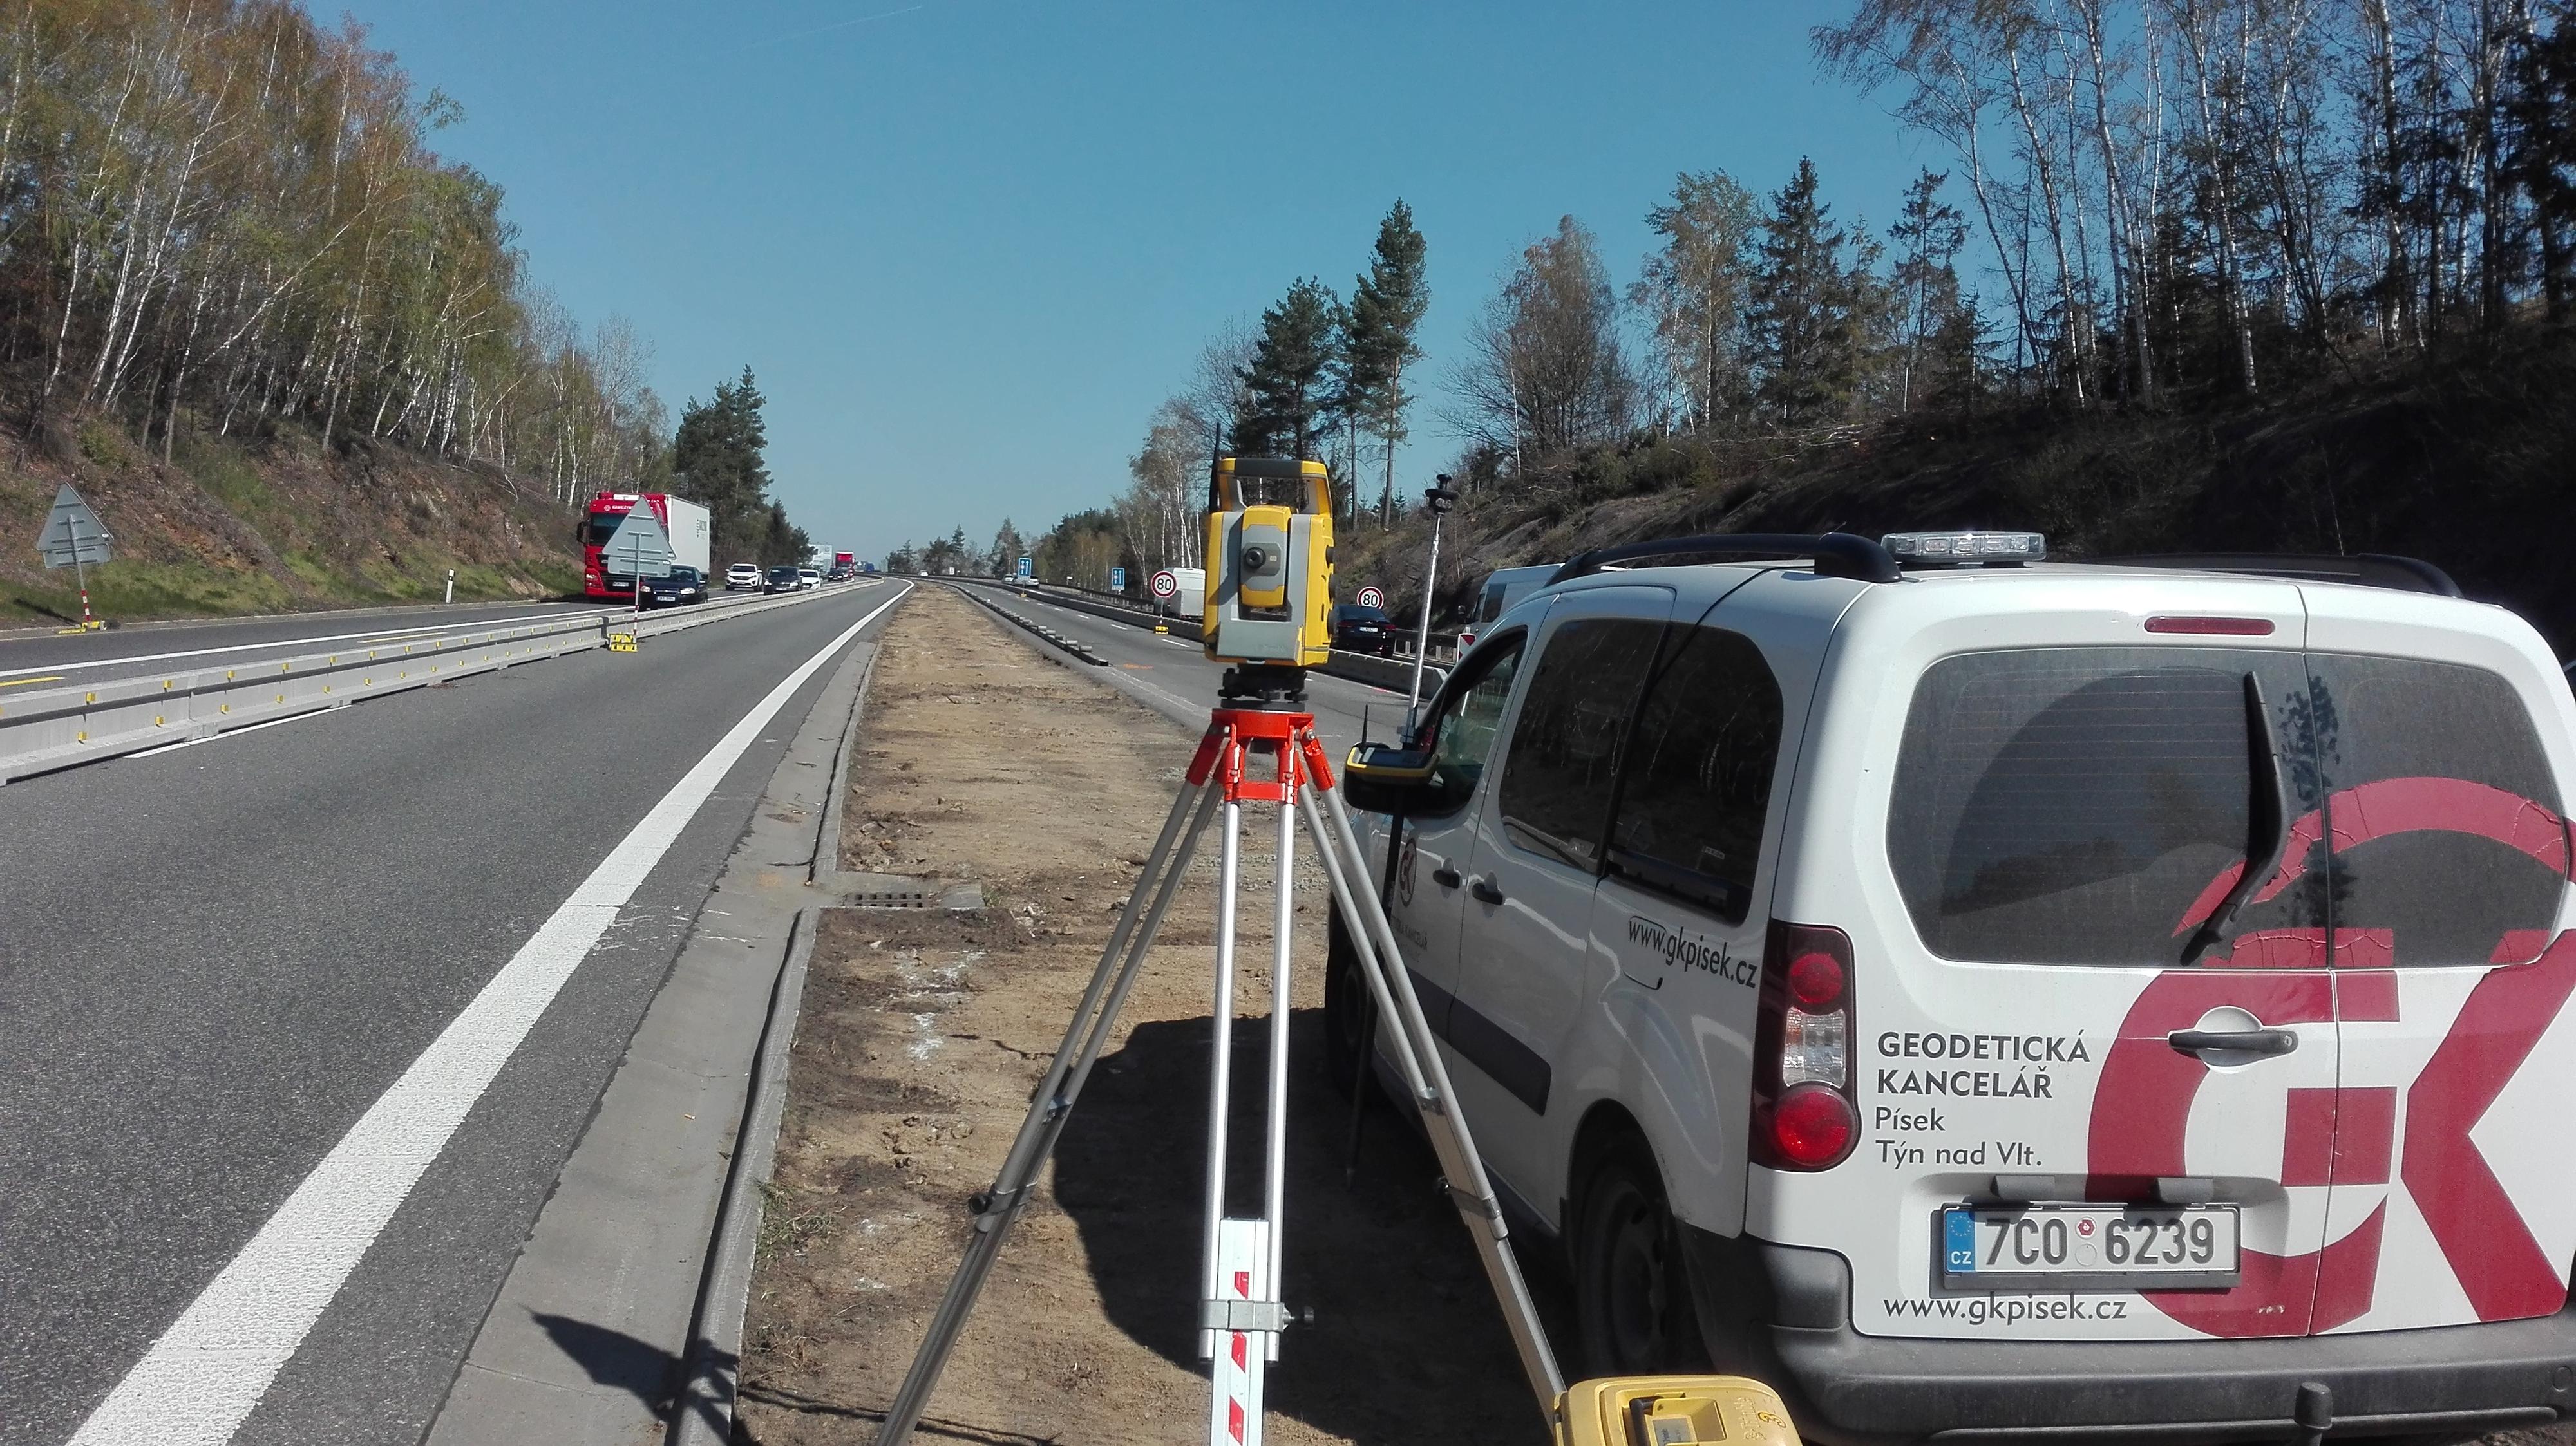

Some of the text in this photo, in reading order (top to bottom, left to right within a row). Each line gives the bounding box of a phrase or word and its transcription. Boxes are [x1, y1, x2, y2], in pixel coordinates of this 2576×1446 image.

[1157, 578, 1171, 590] 80
[1363, 594, 1378, 606] 80
[1628, 920, 1758, 989] www.gkpisek.cz
[1877, 1029, 2090, 1063] GEODETICKÁ
[1877, 1066, 2053, 1099] KANCELÁŘ
[1875, 1106, 1946, 1132] Písek
[1875, 1140, 2043, 1170] Týn nad Vlt.
[1951, 1251, 1971, 1264] CZ
[2106, 1218, 2214, 1266] 6239
[1883, 1293, 2128, 1326] www.gkpisek.cz
